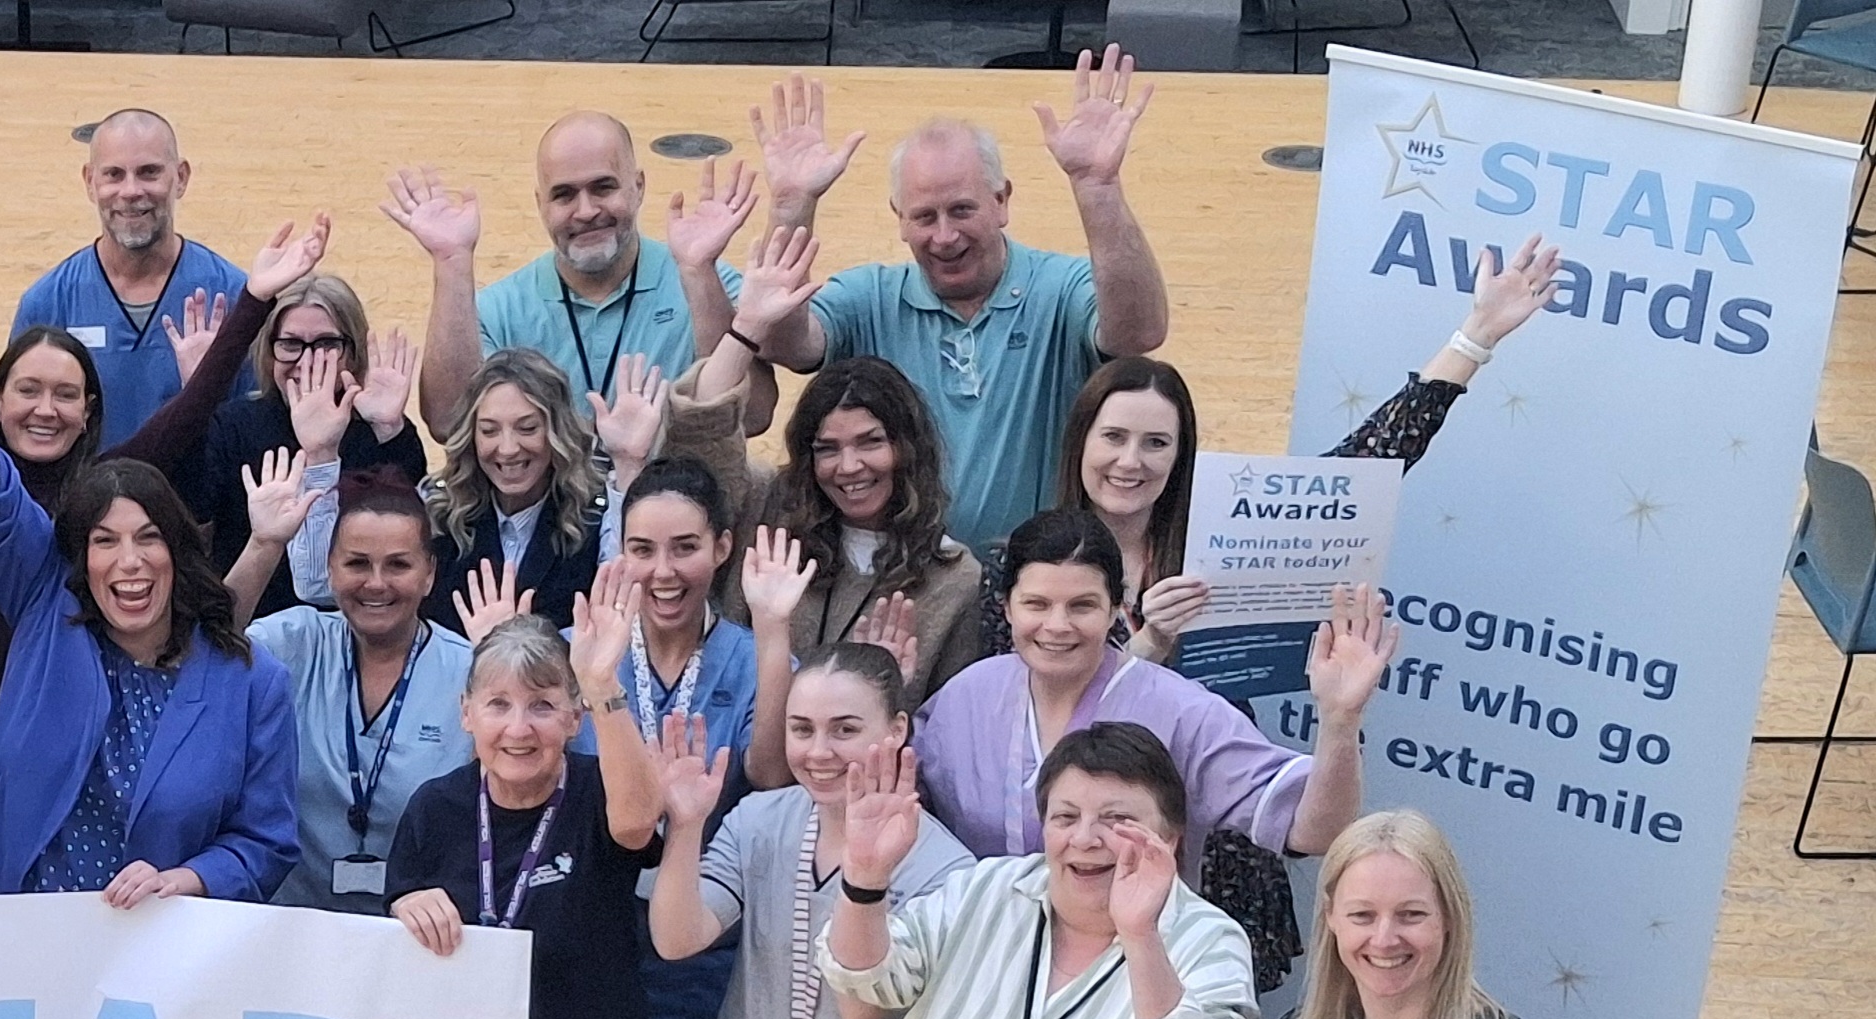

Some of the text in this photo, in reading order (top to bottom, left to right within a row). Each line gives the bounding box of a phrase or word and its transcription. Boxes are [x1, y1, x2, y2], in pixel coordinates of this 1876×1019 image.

[1408, 139, 1444, 159] NHS
[1475, 141, 1755, 265] STAR
[1263, 474, 1352, 496] STAR
[1230, 498, 1358, 520] Awards
[1209, 534, 1370, 552] Nominate your
[1221, 554, 1351, 570] STAR today!
[1378, 587, 1678, 701] ecognising
[1459, 680, 1671, 765] who go
[1386, 737, 1535, 803] extra
[1556, 783, 1683, 843] mile
